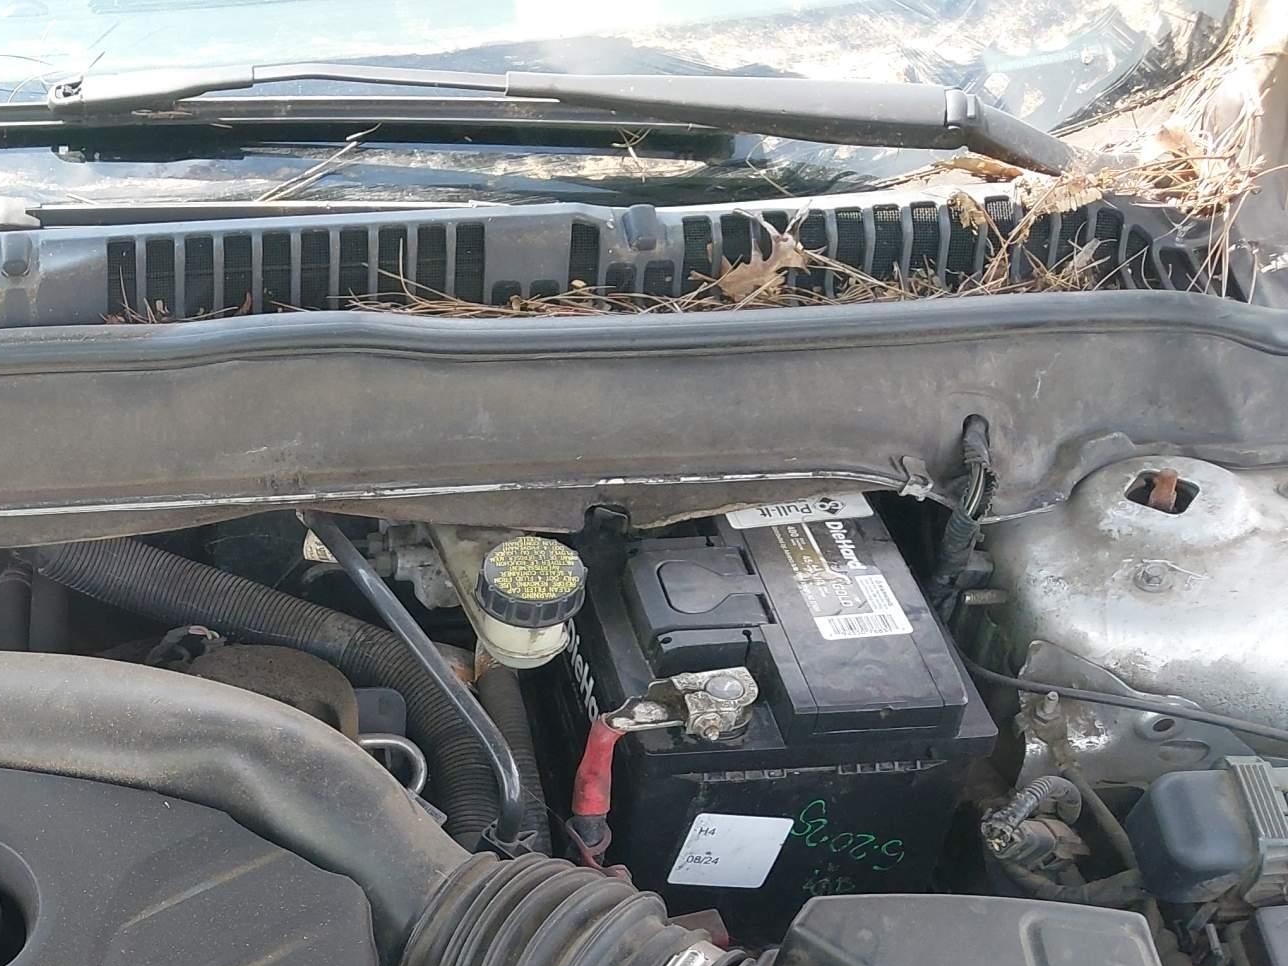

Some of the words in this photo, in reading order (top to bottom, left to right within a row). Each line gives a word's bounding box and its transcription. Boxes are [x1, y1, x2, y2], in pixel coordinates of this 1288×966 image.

[759, 503, 812, 517] Pull-It
[825, 520, 869, 571] DieHard
[567, 617, 600, 722] DieHa
[698, 827, 717, 836] H4
[685, 854, 720, 865] 08/24
